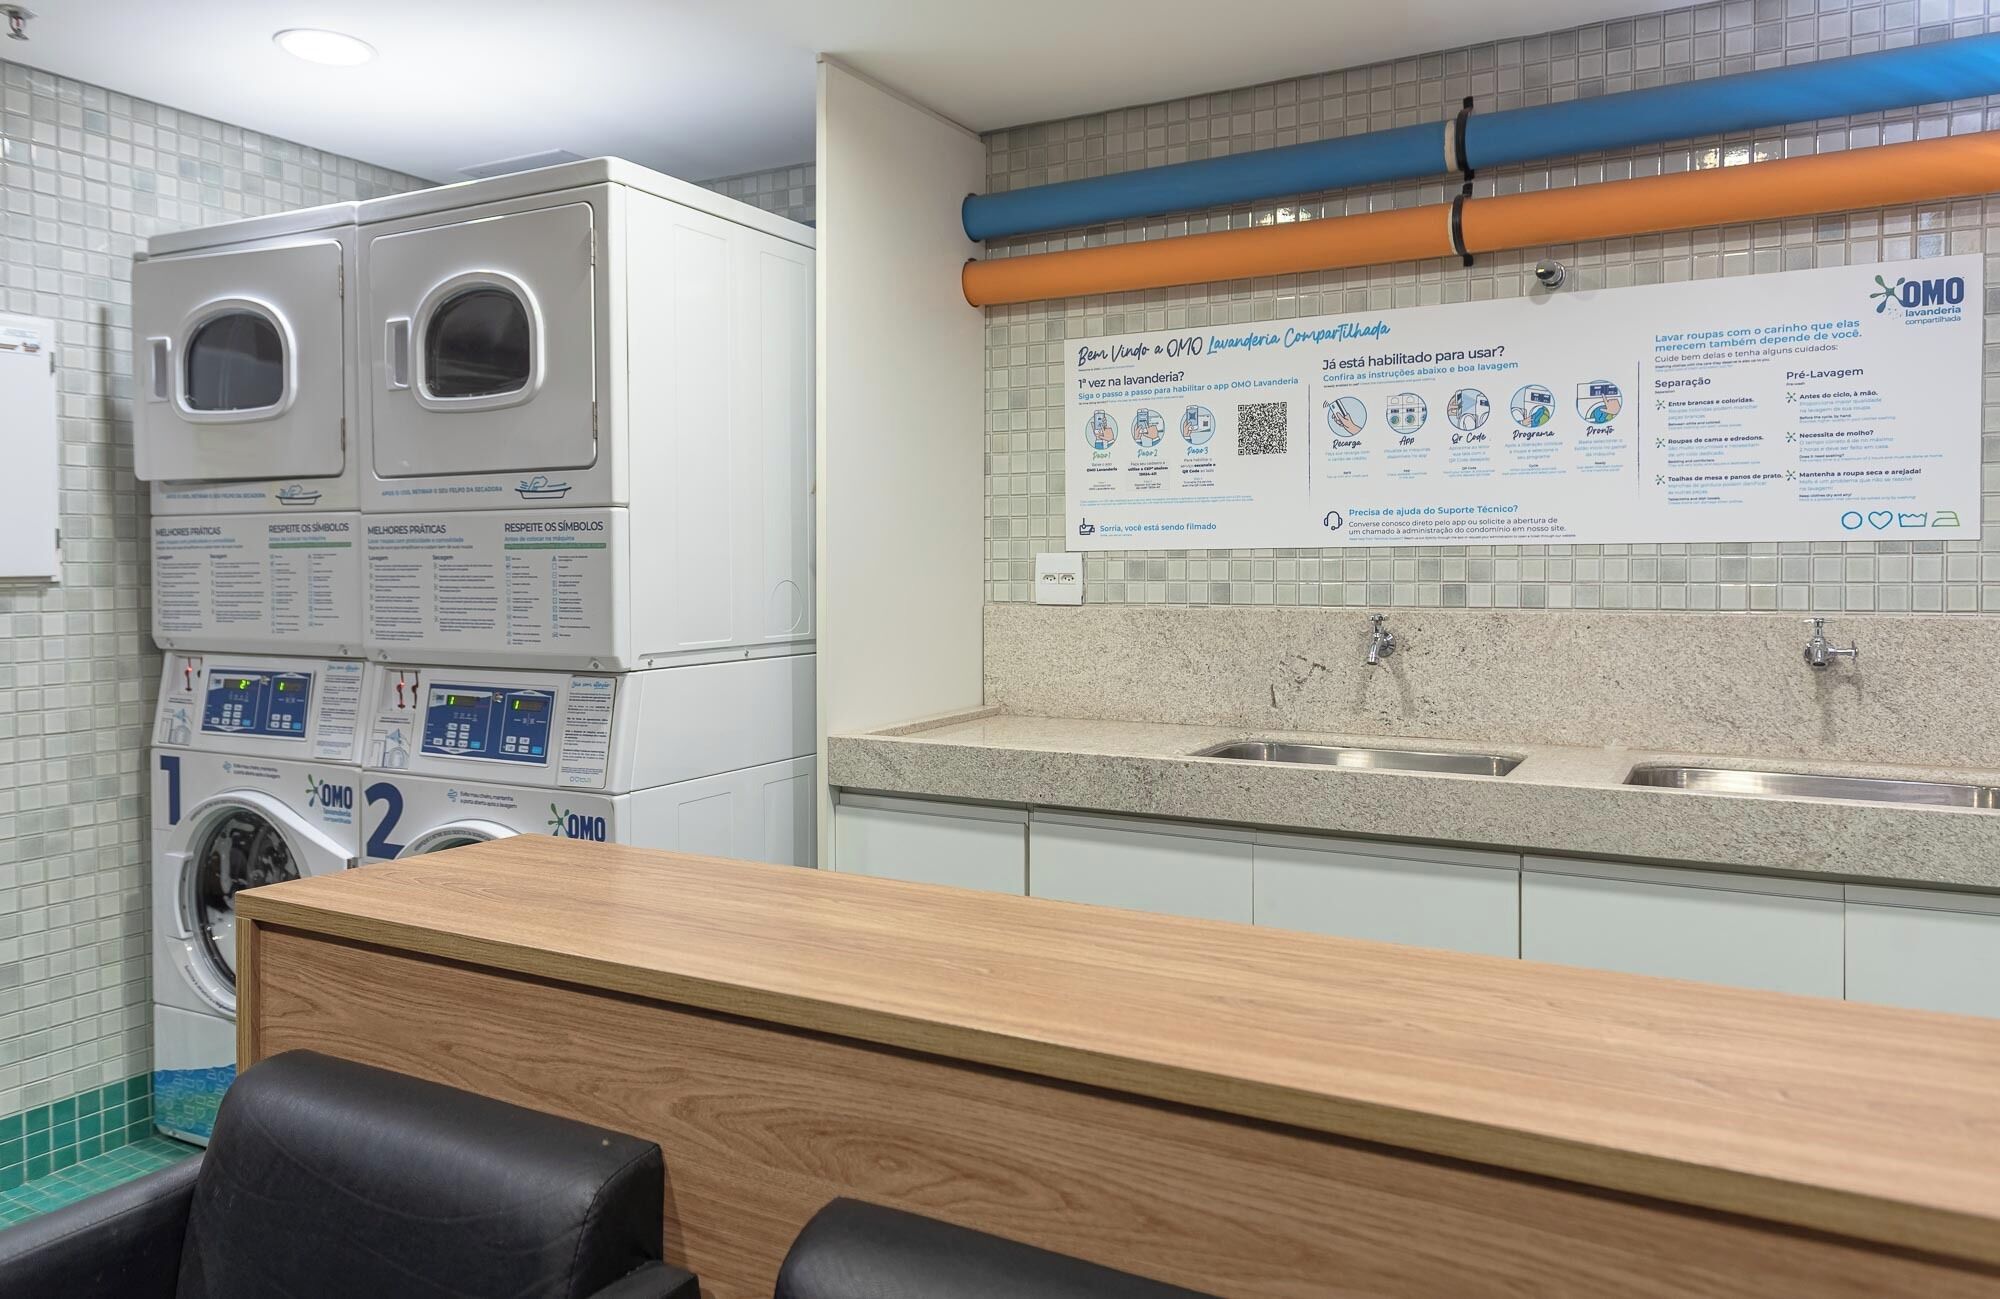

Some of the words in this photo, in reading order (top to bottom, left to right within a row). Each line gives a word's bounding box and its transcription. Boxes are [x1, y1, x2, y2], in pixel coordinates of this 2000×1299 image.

[1902, 277, 1964, 308] OMO
[1906, 306, 1961, 317] lavanderia
[1905, 316, 1961, 325] compartilhada
[1656, 334, 1684, 343] Lavar
[1687, 330, 1724, 340] roupas
[1727, 329, 1751, 340] com
[1764, 323, 1808, 338] carinho
[1811, 322, 1833, 335] que
[1836, 320, 1861, 333] elas
[1655, 342, 1706, 353] merecem
[1709, 338, 1756, 348] também
[1760, 334, 1811, 345] depende
[1814, 332, 1829, 341] de
[1832, 330, 1862, 339] você.
[1078, 346, 1108, 366] Bem
[1112, 342, 1150, 362] Vindo
[1154, 344, 1163, 354] a
[1167, 336, 1203, 357] OMO
[1206, 333, 1280, 355] Lavanderia
[1654, 355, 1679, 363] Cuide
[1735, 349, 1760, 358] tenha
[1763, 348, 1793, 357] alguns
[1795, 344, 1838, 353] cuidados:
[1323, 358, 1336, 371] Já
[1339, 356, 1365, 369] está
[1368, 352, 1432, 367] habilitado
[1436, 351, 1465, 365] para
[1468, 346, 1505, 359] usar?
[1323, 373, 1355, 382] Confira
[1368, 369, 1415, 379] instruções
[1417, 366, 1447, 375] abaixo
[1478, 362, 1519, 371] lavagem
[1786, 368, 1864, 380] Pré-Lavagem
[1655, 376, 1711, 389] Separação
[1078, 393, 1094, 401] Siga
[1102, 391, 1123, 401] passo
[1130, 387, 1153, 398] passo
[1154, 386, 1171, 396] para
[1173, 384, 1205, 393] habilitar
[1231, 382, 1251, 390] OMO
[1254, 378, 1299, 387] Lavanderia
[1513, 430, 1555, 440] Programa
[1586, 426, 1614, 436] Pronto
[1400, 436, 1414, 445] App
[1466, 432, 1486, 443] Code
[1332, 439, 1362, 449] Recarga
[1349, 508, 1381, 516] Precisa
[1396, 507, 1421, 517] ajuda
[1424, 507, 1436, 515] do
[1438, 507, 1475, 516] Suporte
[1477, 505, 1518, 513] Técnico?
[269, 524, 300, 533] RESPEITE
[301, 524, 311, 532] OS
[312, 521, 349, 532] SÍMBOLOS
[368, 526, 408, 535] MELHORES
[408, 523, 446, 534] PRÁTICAS
[505, 522, 543, 532] RESPEITE
[544, 522, 557, 532] OS
[558, 519, 603, 531] SÍMBOLOS
[1100, 524, 1123, 532] Sorria,
[1125, 524, 1142, 532] você
[1144, 523, 1160, 531] está
[1161, 523, 1185, 533] sendo
[1186, 522, 1217, 531] filmado
[1381, 520, 1411, 529] conosco
[1412, 520, 1433, 528] direto
[1434, 520, 1451, 528] pelo
[1479, 518, 1506, 527] solicite
[1548, 517, 1558, 526] de
[156, 528, 189, 536] MELHORES
[1402, 526, 1454, 535] administração
[1466, 526, 1511, 535] condomínio
[160, 755, 180, 825] 1
[322, 784, 352, 809] OMO
[364, 782, 405, 859] 2
[568, 814, 605, 842] OMO
